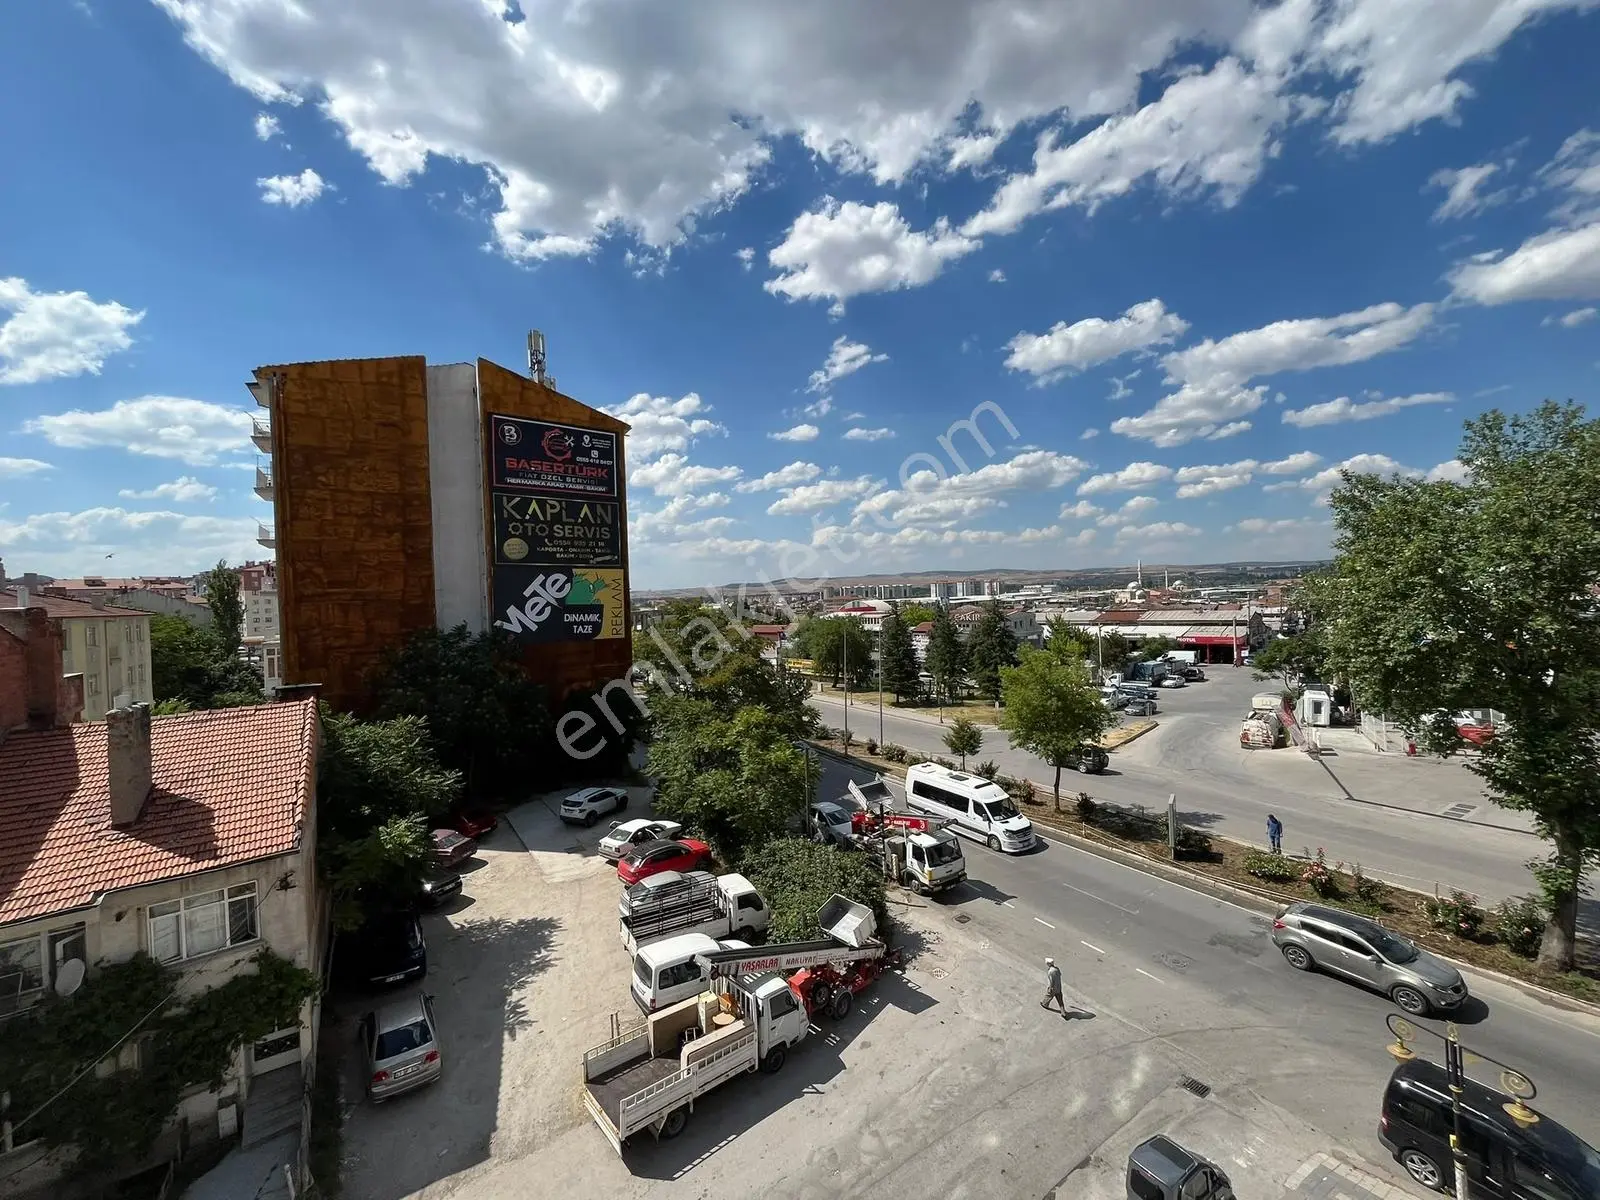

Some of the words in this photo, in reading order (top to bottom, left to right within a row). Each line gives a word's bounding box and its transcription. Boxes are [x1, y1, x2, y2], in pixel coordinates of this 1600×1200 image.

[502, 496, 612, 525] KAPLAN
[508, 522, 549, 537] OTO
[611, 578, 623, 636] REKLAM
[573, 625, 593, 634] TAZE
